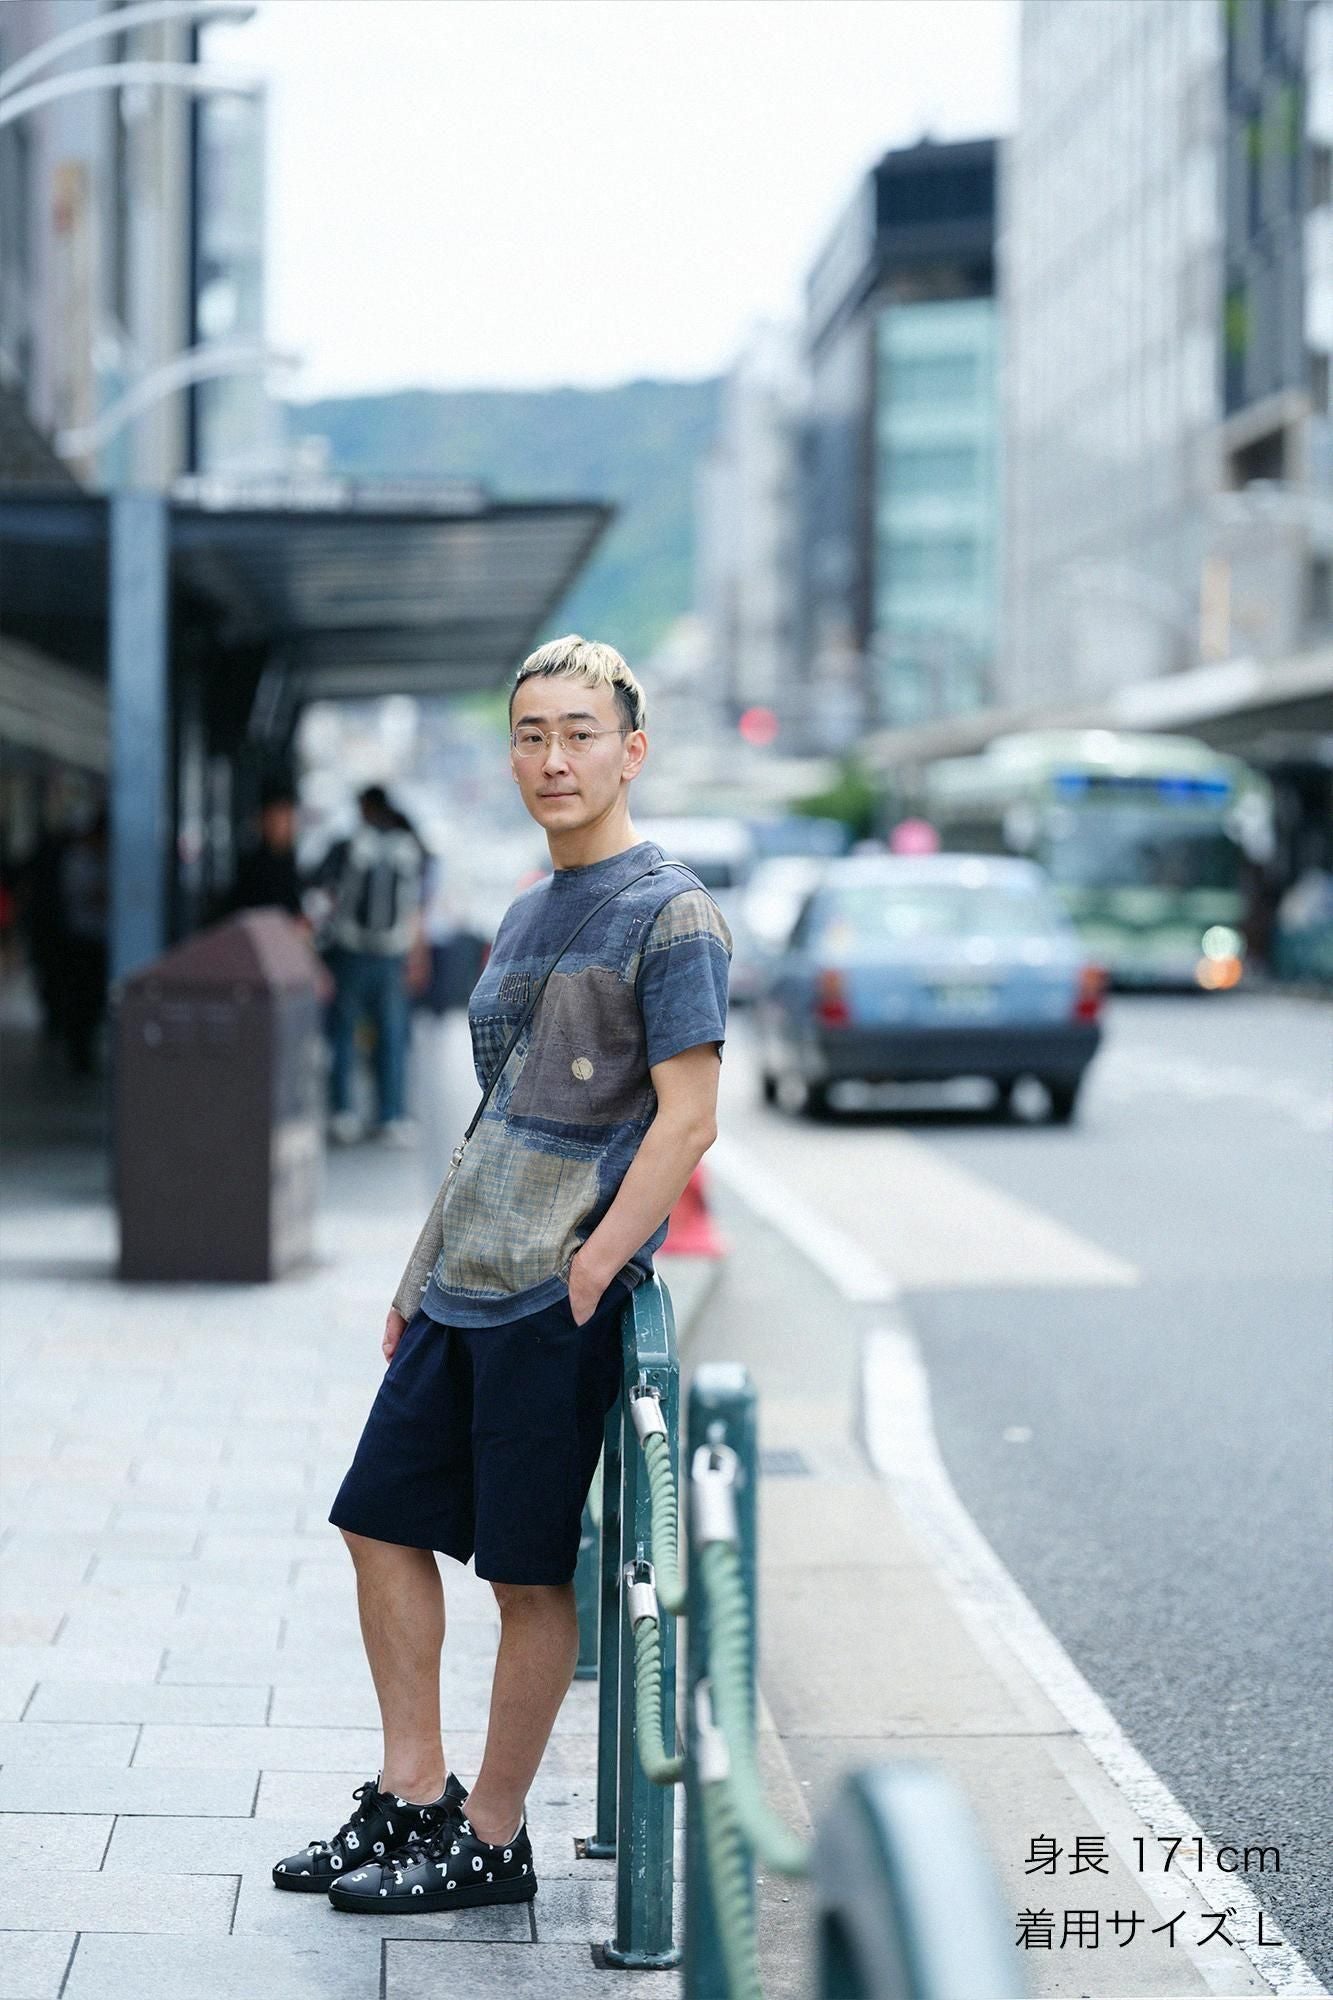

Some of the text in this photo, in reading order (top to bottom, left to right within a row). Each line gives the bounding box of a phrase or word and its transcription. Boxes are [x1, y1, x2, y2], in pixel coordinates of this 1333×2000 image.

[345, 1831, 359, 1850] 8
[373, 1841, 385, 1857] 9
[503, 1849, 513, 1863] 9
[330, 1855, 343, 1870] 0
[435, 1863, 447, 1877] 7
[472, 1856, 483, 1871] 0
[352, 1873, 368, 1882] 5
[393, 1870, 404, 1885] 3
